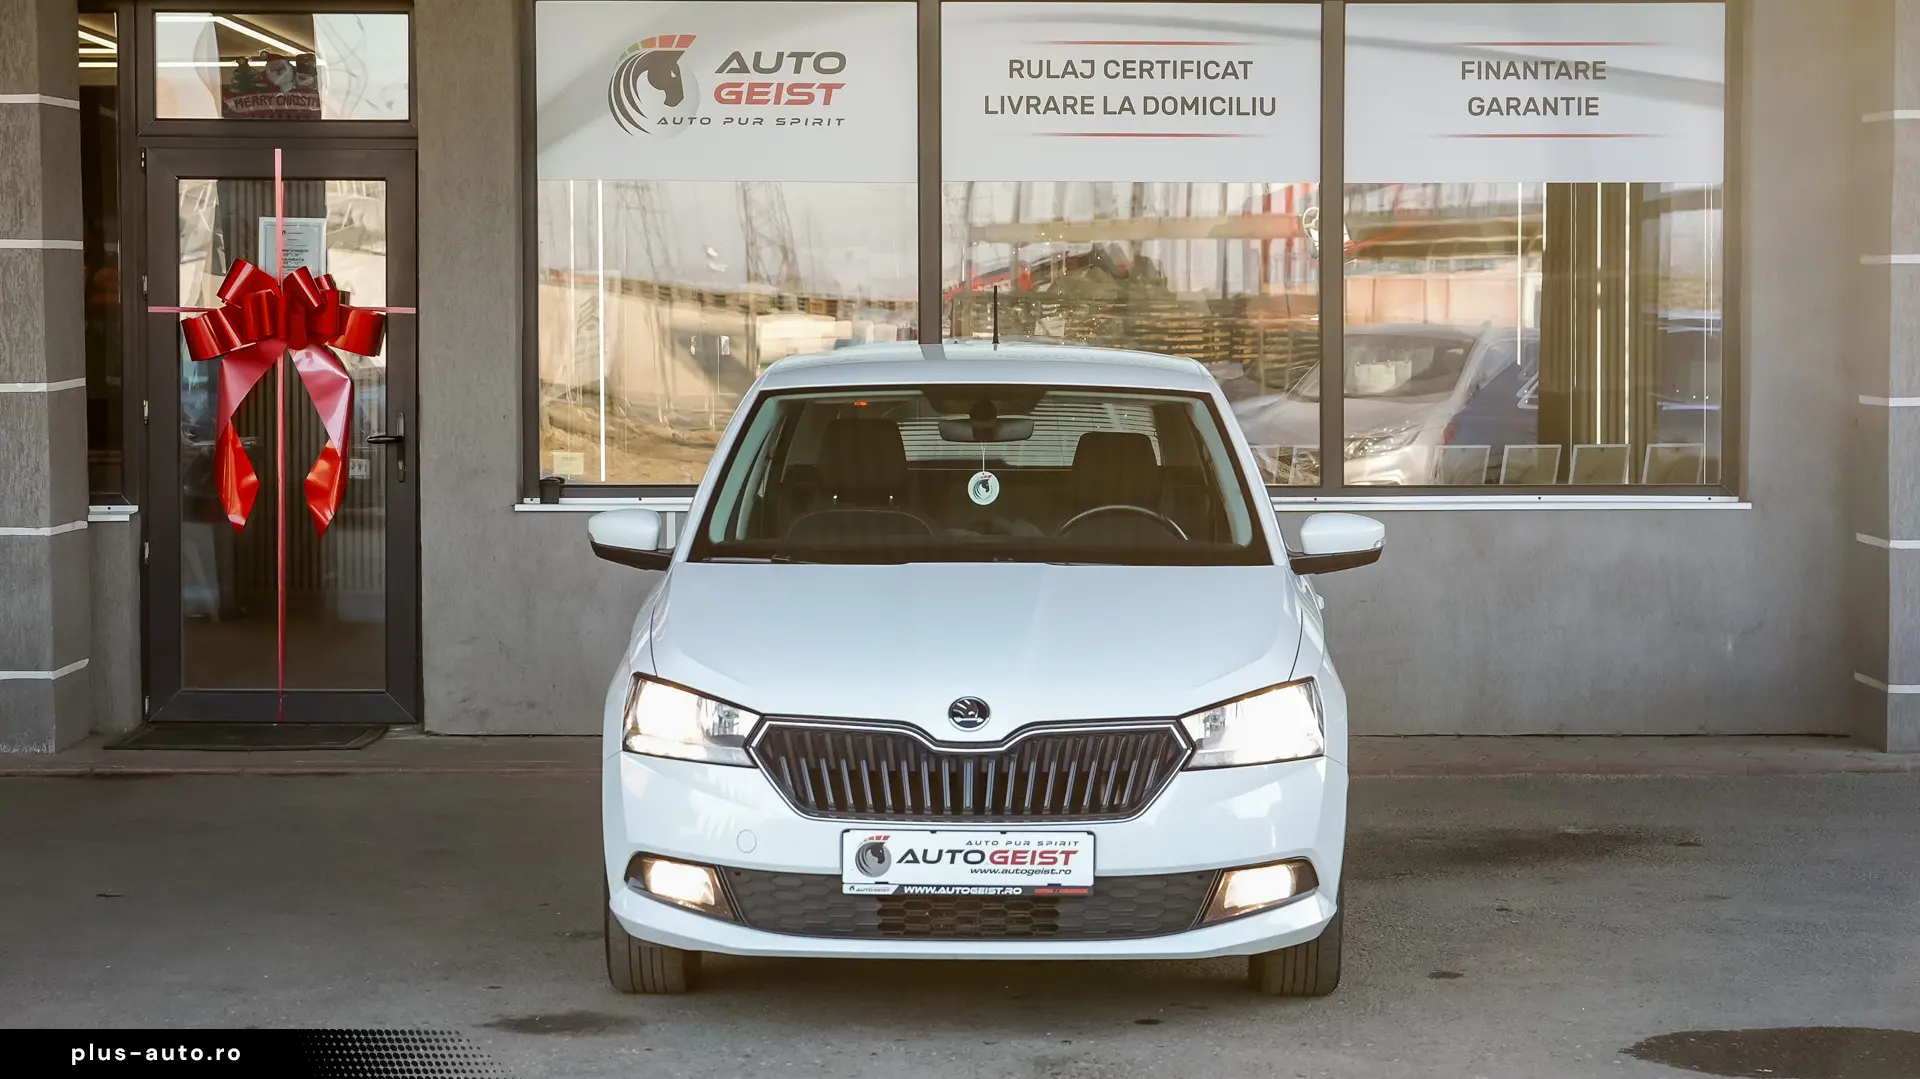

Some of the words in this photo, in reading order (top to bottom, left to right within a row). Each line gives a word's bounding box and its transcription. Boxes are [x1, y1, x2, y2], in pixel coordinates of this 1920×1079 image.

[714, 50, 847, 75] AUTO
[1008, 59, 1096, 80] RULAJ
[1103, 59, 1254, 80] CERTIFICAT
[1461, 60, 1607, 81] FINANTARE
[233, 95, 272, 109] MERRY
[713, 82, 846, 106] GEIST
[984, 95, 1095, 115] LIVRARE
[1103, 95, 1137, 116] LA
[1143, 96, 1277, 117] DOMICILIU
[1467, 96, 1600, 117] GARANTIE
[657, 116, 712, 126] AUTO
[723, 117, 764, 126] PUR
[775, 117, 846, 127] SPIRIT
[896, 848, 1079, 866] AUTOGEIST
[970, 867, 1072, 876] www.autogeist.ro
[903, 885, 1023, 895] WWW.AUTOGEIST.RO
